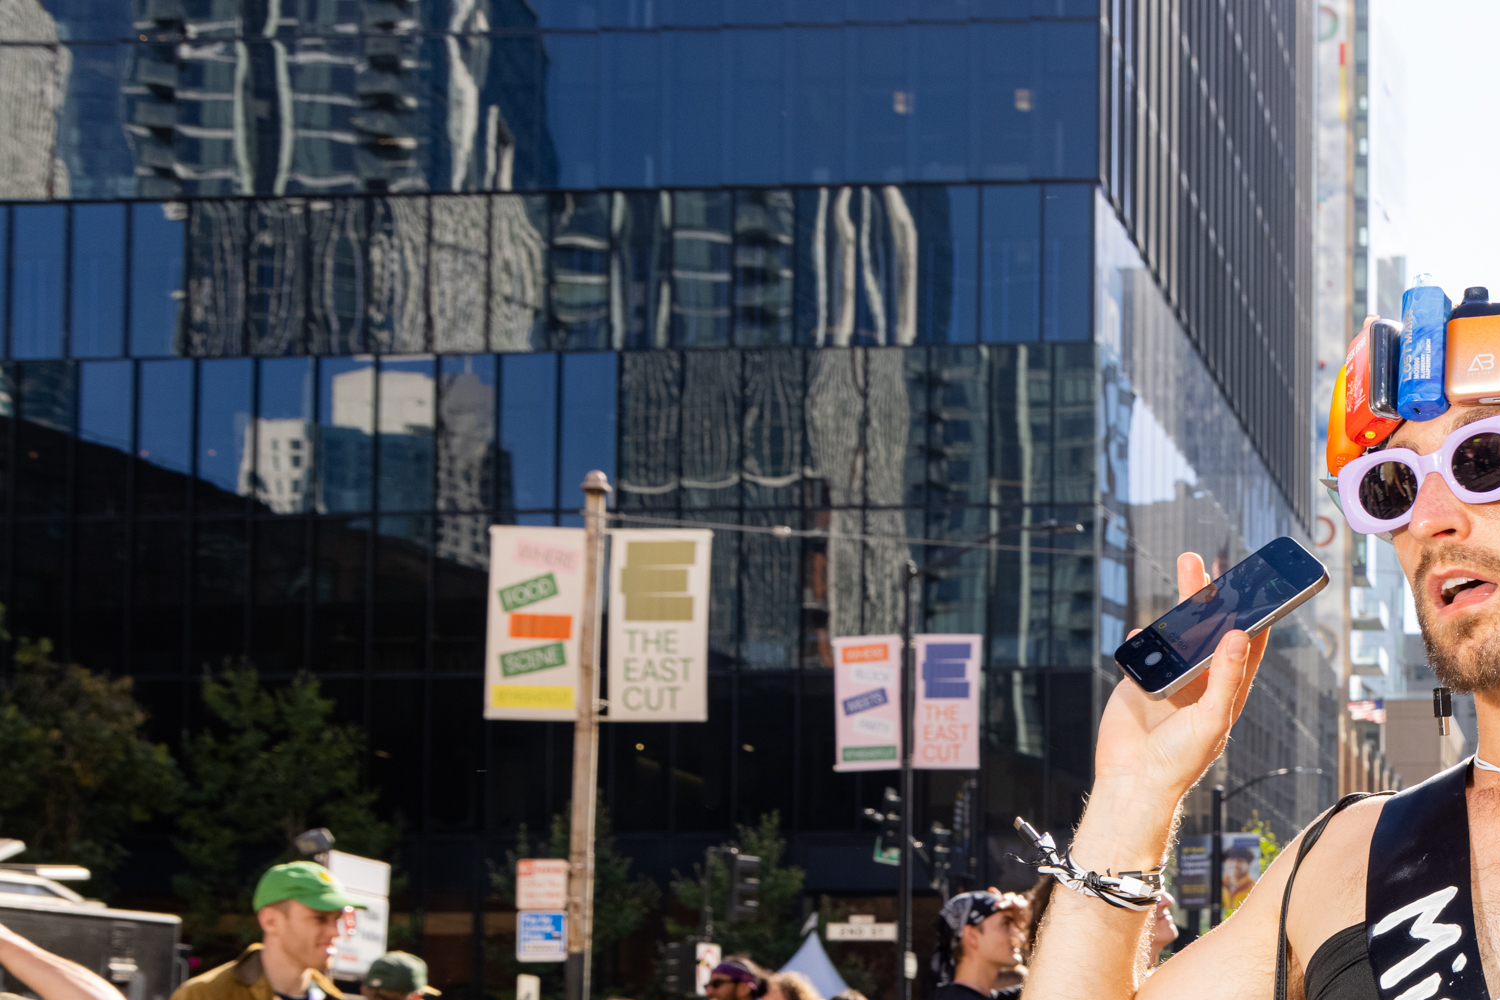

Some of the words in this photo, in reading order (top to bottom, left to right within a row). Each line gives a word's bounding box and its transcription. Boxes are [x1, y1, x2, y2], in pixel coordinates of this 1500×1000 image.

[1404, 310, 1414, 345] MARY
[1403, 348, 1413, 382] LOST
[518, 543, 574, 569] WHERE
[502, 577, 555, 608] FOOD
[623, 629, 678, 654] THE
[503, 645, 562, 674] SCENE
[623, 657, 694, 682] EAST
[621, 686, 682, 711] CUT
[925, 704, 960, 722] THE
[923, 724, 970, 742] EAST
[922, 744, 961, 762] CUT
[839, 926, 863, 936] 2ND
[870, 926, 885, 936] ST
